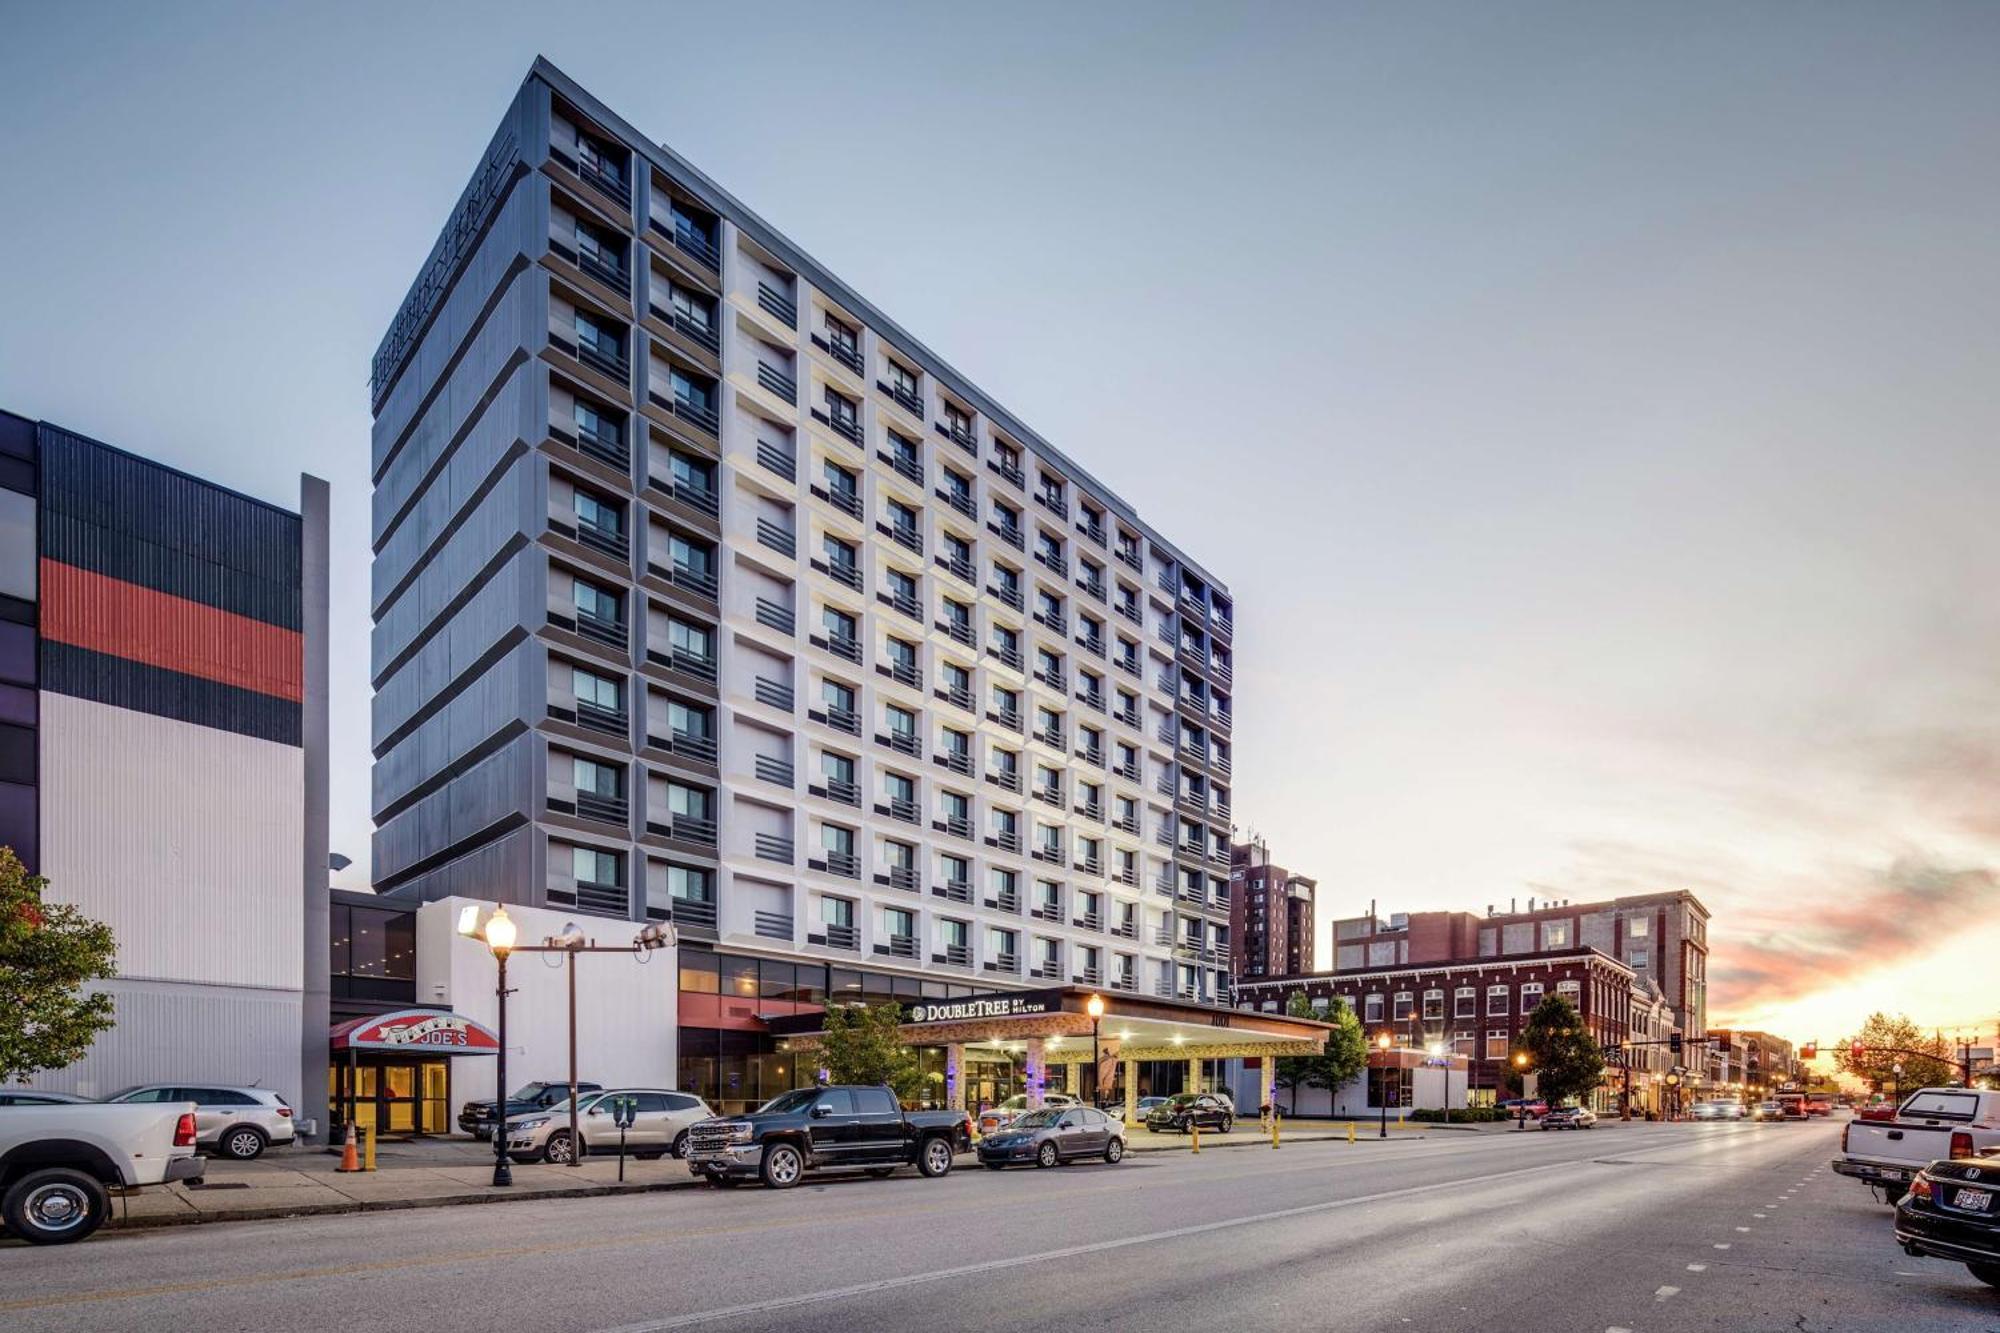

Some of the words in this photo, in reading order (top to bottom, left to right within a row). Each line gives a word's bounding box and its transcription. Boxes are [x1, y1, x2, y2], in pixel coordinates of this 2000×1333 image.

[927, 1000, 1010, 1020] DOUBLETREE
[1012, 1004, 1045, 1014] HILTON
[421, 1032, 467, 1046] JOE'S
